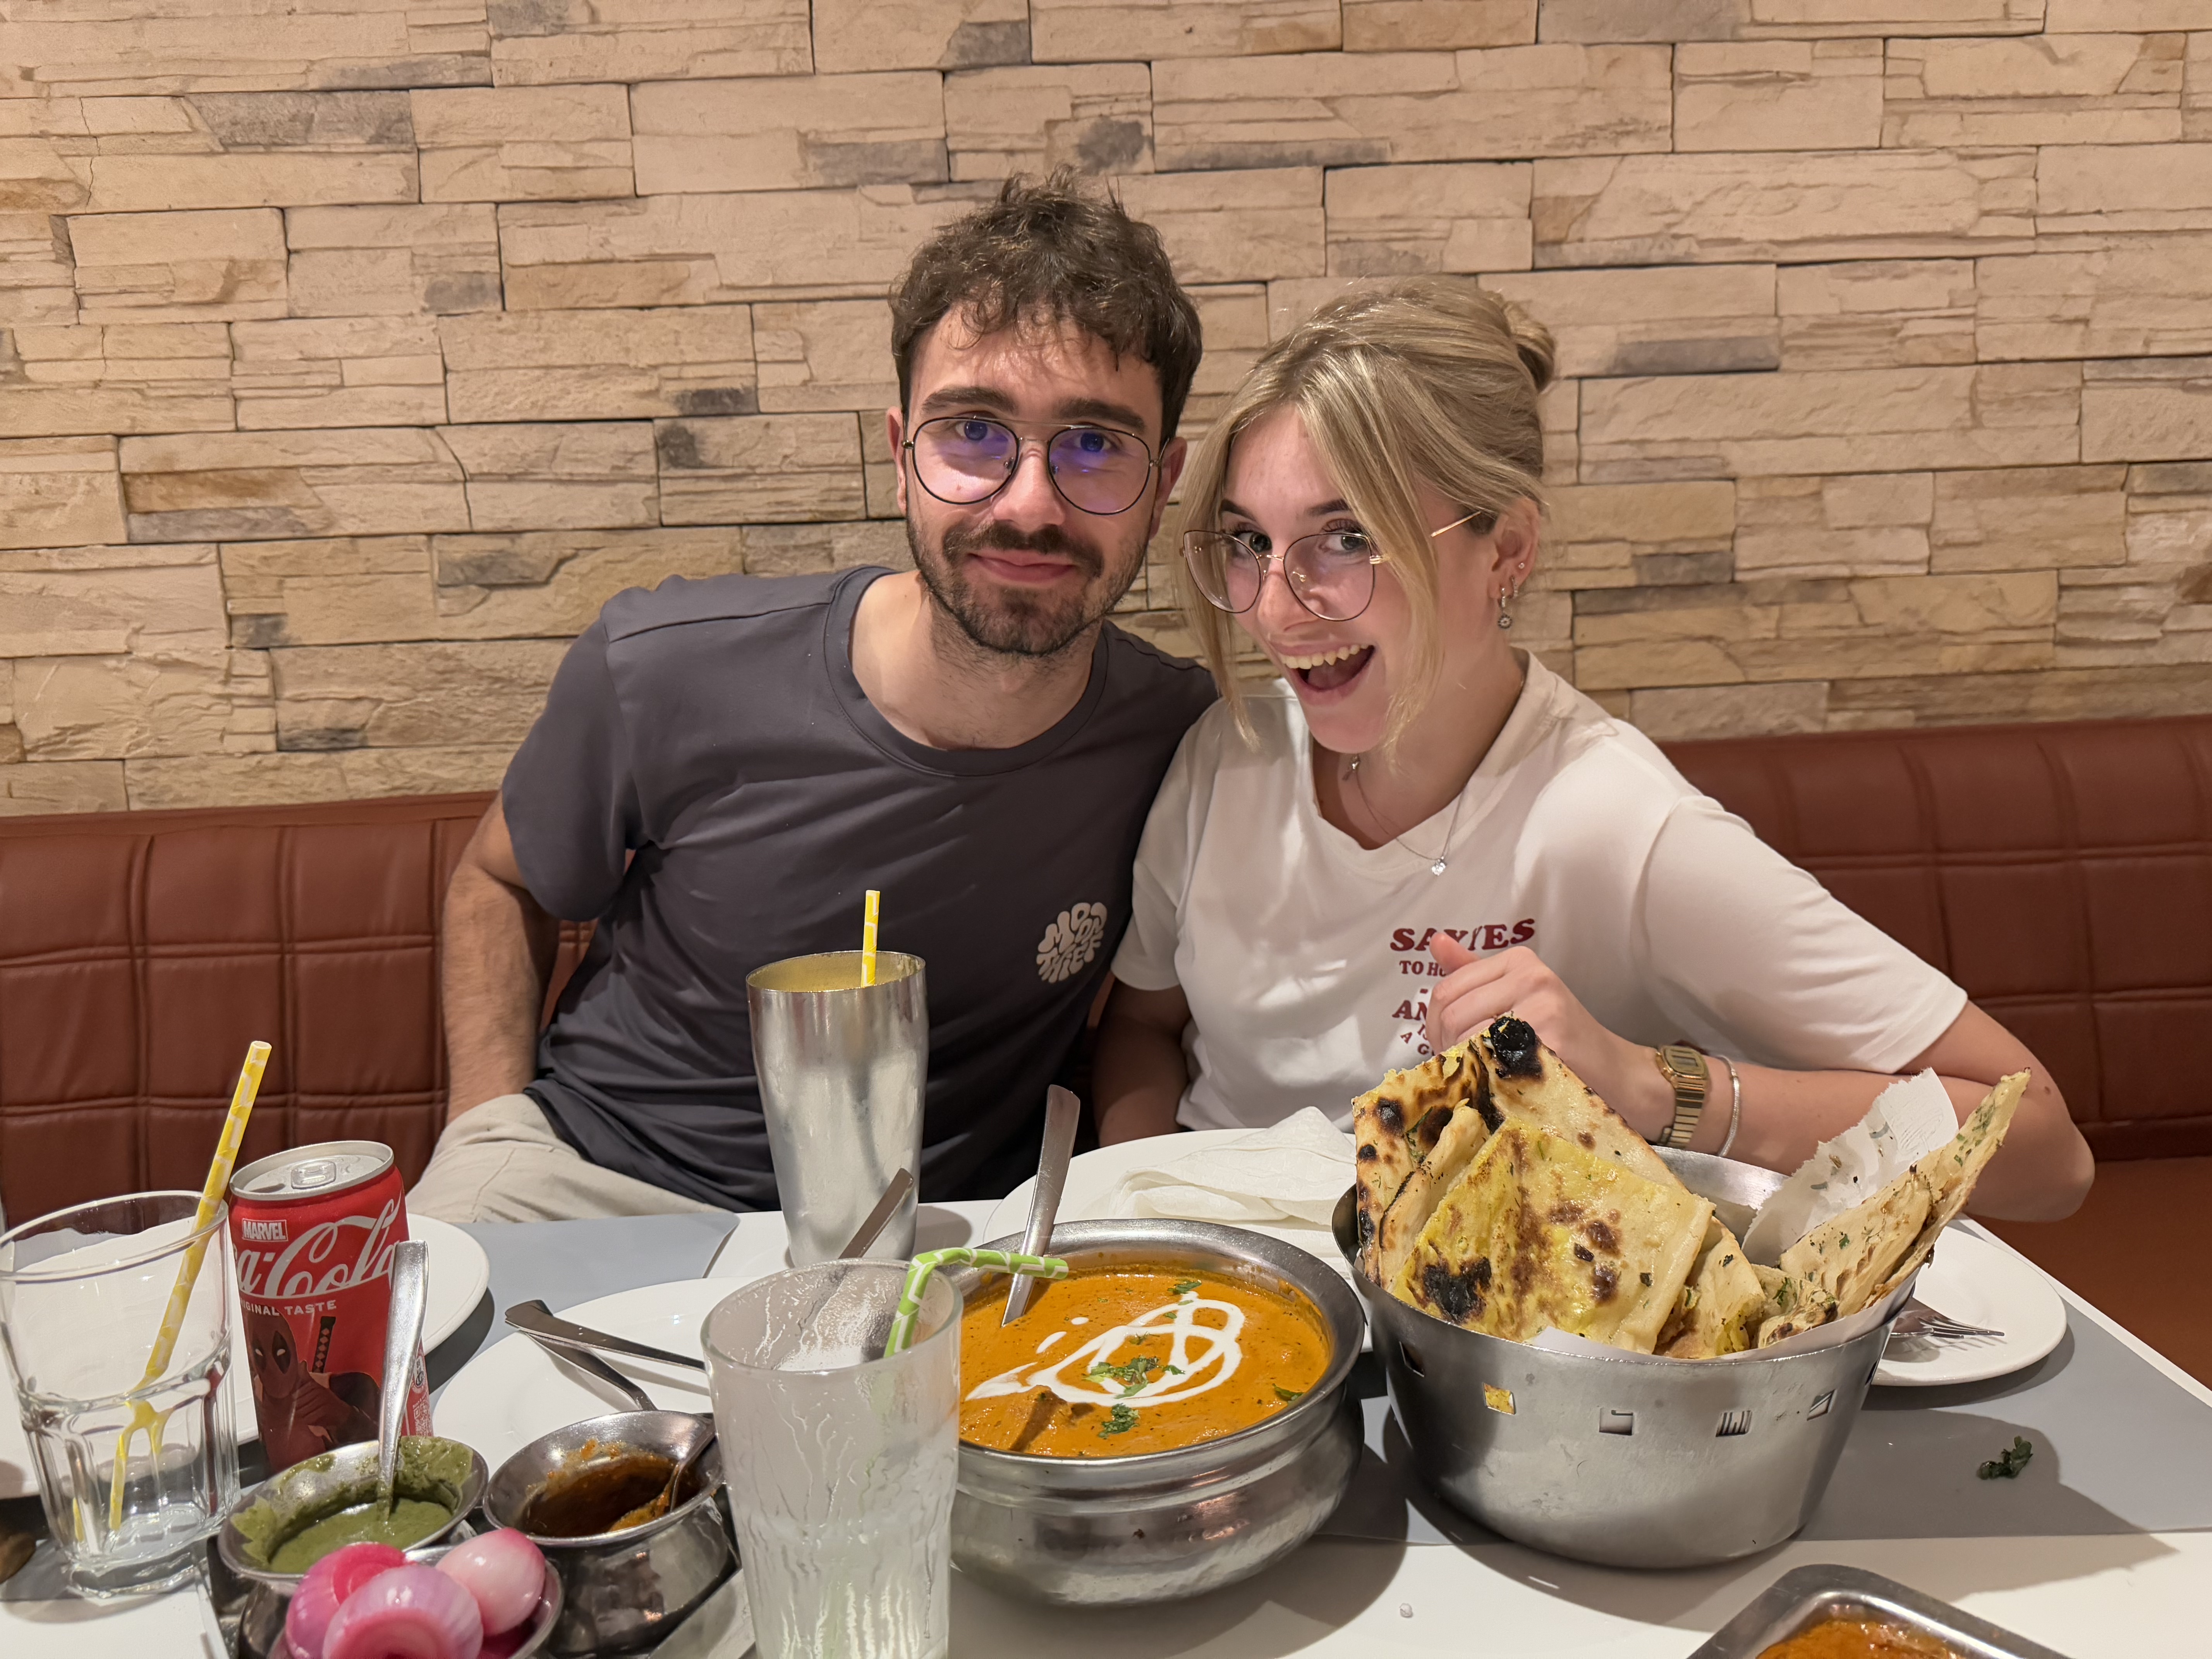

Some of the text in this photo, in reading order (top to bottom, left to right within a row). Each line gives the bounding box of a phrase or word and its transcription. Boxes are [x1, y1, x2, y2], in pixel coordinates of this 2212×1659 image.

[1399, 960, 1424, 975] TO
[243, 1220, 286, 1240] MARVEL
[284, 1300, 337, 1315] TASTE
